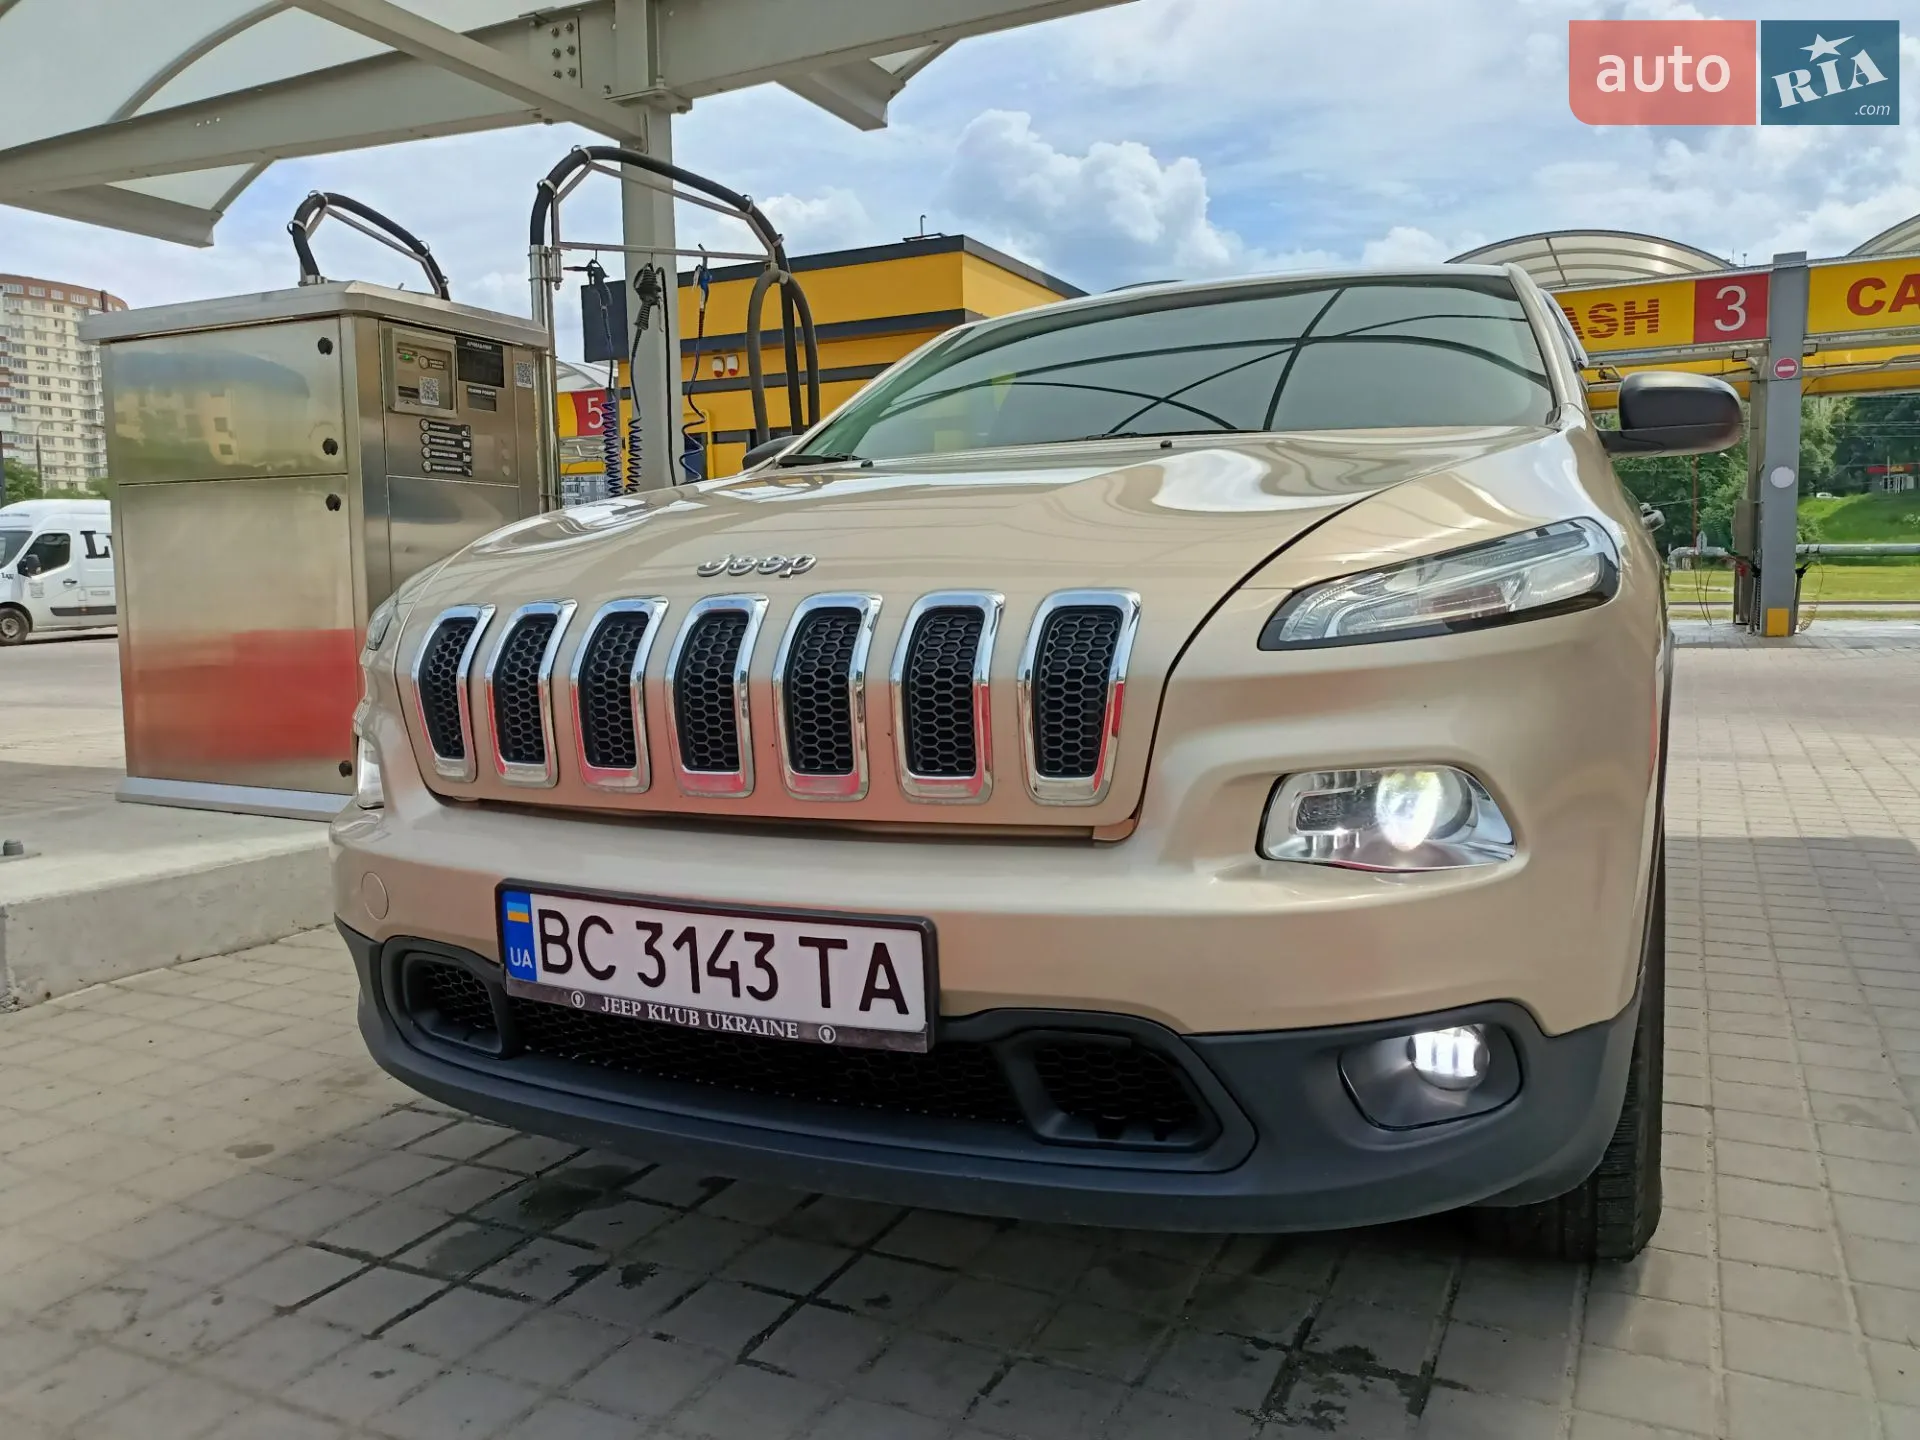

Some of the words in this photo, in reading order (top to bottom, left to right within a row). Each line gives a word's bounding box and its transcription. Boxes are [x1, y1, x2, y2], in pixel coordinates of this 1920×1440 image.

[1714, 285, 1747, 332] 3
[587, 397, 604, 429] 5
[80, 530, 112, 559] L
[697, 553, 817, 579] Jeep
[510, 946, 533, 969] UA
[538, 908, 616, 981] BC
[636, 920, 778, 1001] 3143
[798, 936, 909, 1015] TA
[601, 996, 641, 1017] JEEP
[647, 1003, 700, 1026] KL'UB
[706, 1013, 799, 1039] UKRAINE
